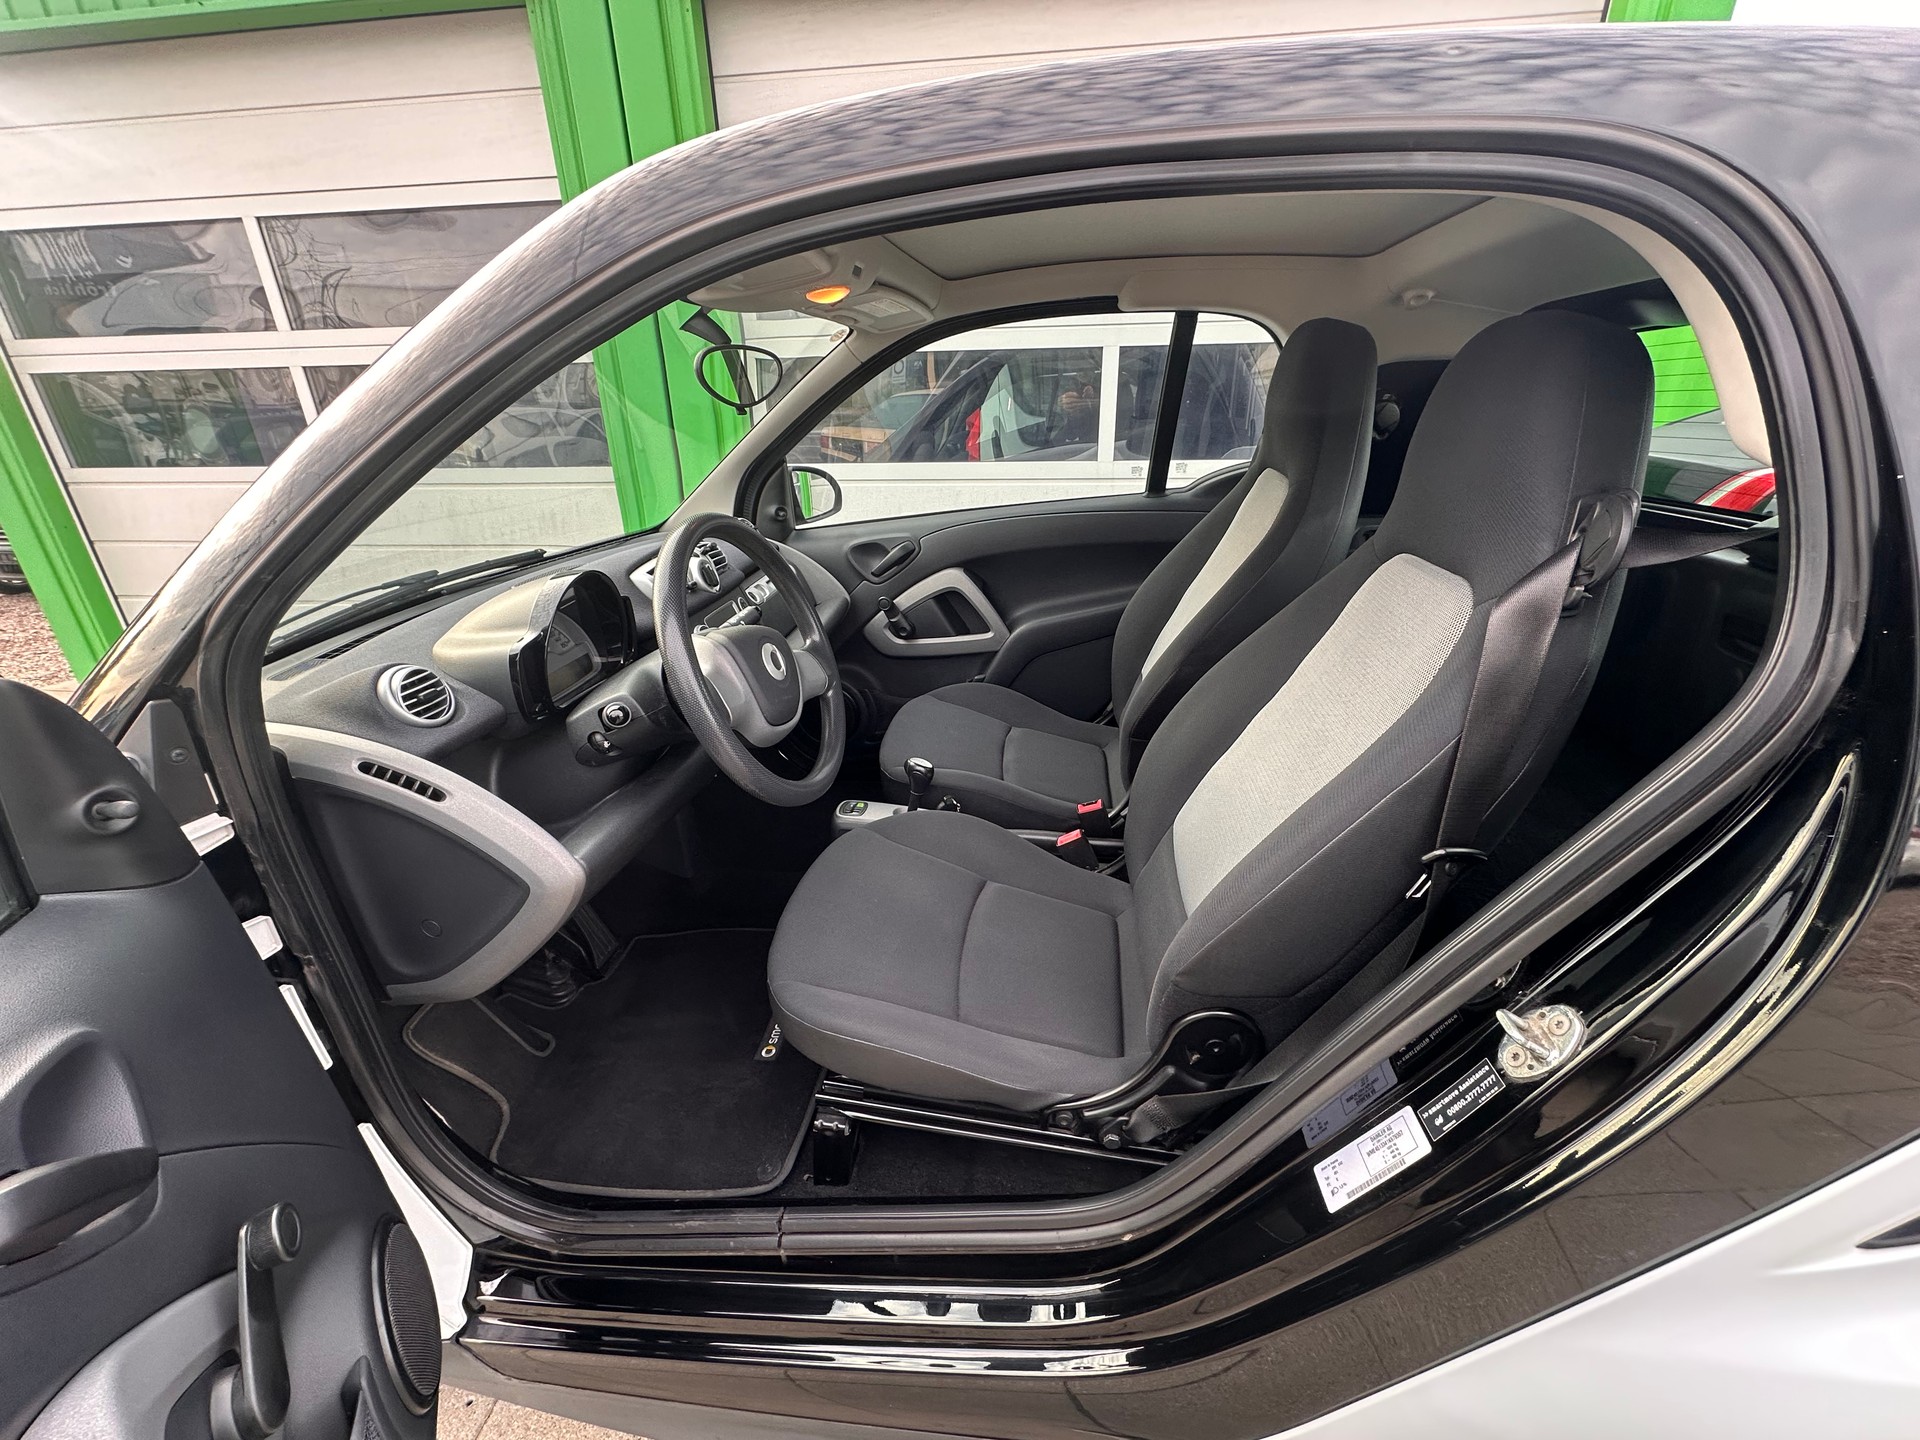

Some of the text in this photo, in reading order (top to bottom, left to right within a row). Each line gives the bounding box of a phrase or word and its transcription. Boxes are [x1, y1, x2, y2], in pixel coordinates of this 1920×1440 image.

[1428, 1090, 1459, 1115] smartmove
[1458, 1065, 1490, 1092] Assistance
[1446, 1074, 1496, 1117] 00800.2777.7777
